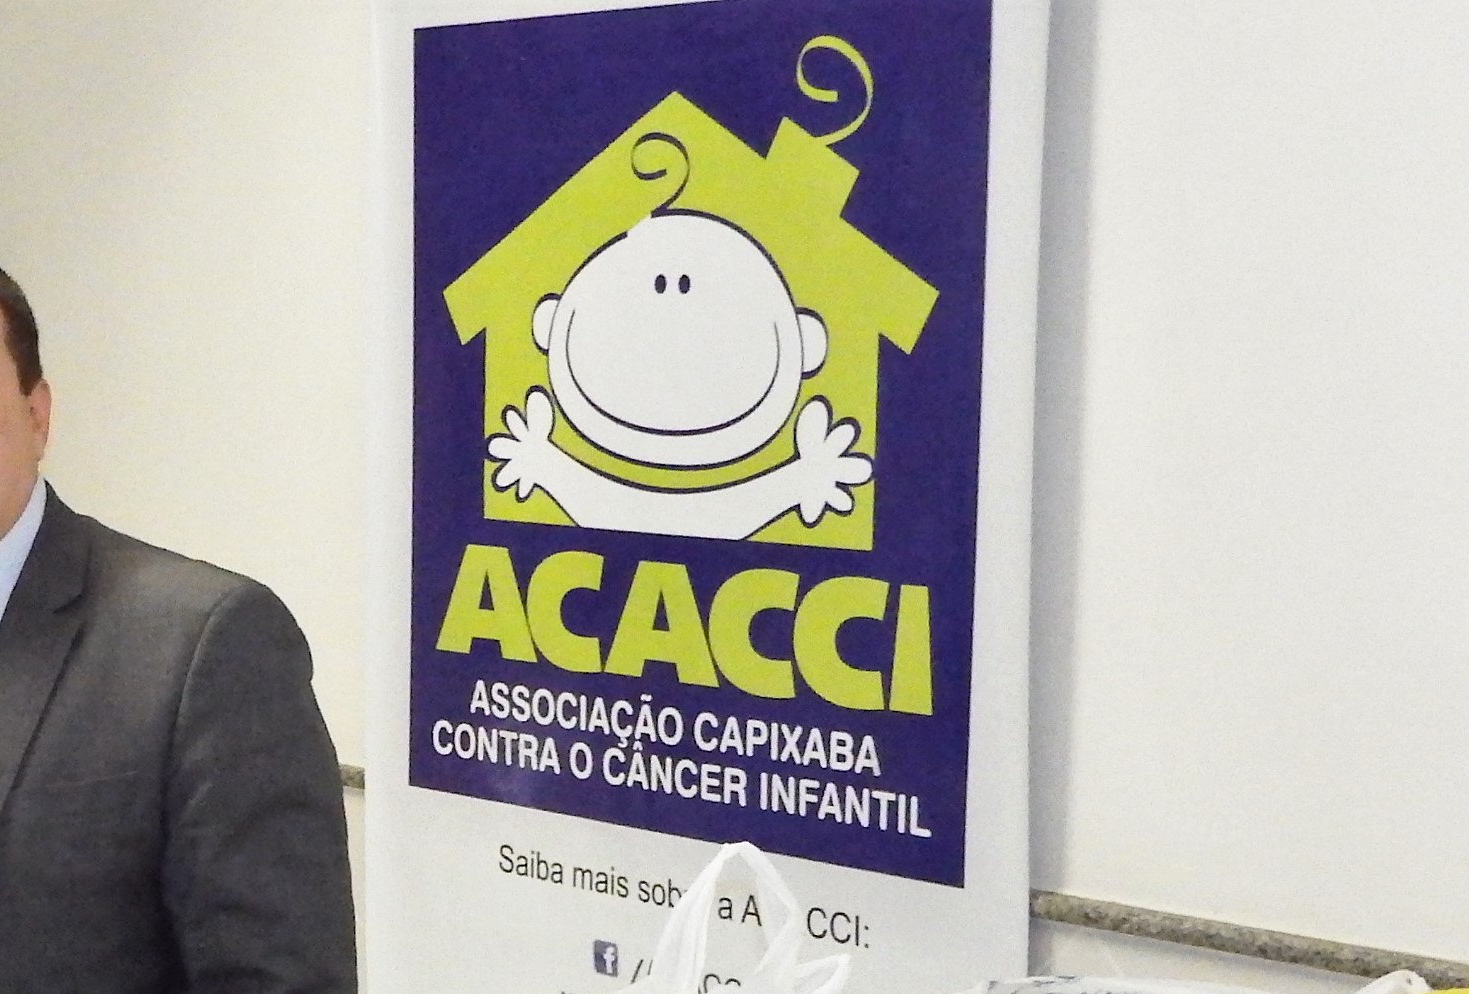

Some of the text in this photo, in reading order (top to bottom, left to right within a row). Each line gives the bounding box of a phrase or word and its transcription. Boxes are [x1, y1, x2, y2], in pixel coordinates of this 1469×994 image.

[435, 543, 933, 716] ACACCI
[432, 720, 932, 838] CONTRA O CÂNCER INFANTIL
[470, 679, 881, 777] ASSOCIAÇÃO CAPIXABA
[499, 845, 870, 949] Saiba mais sob a ACCI:
